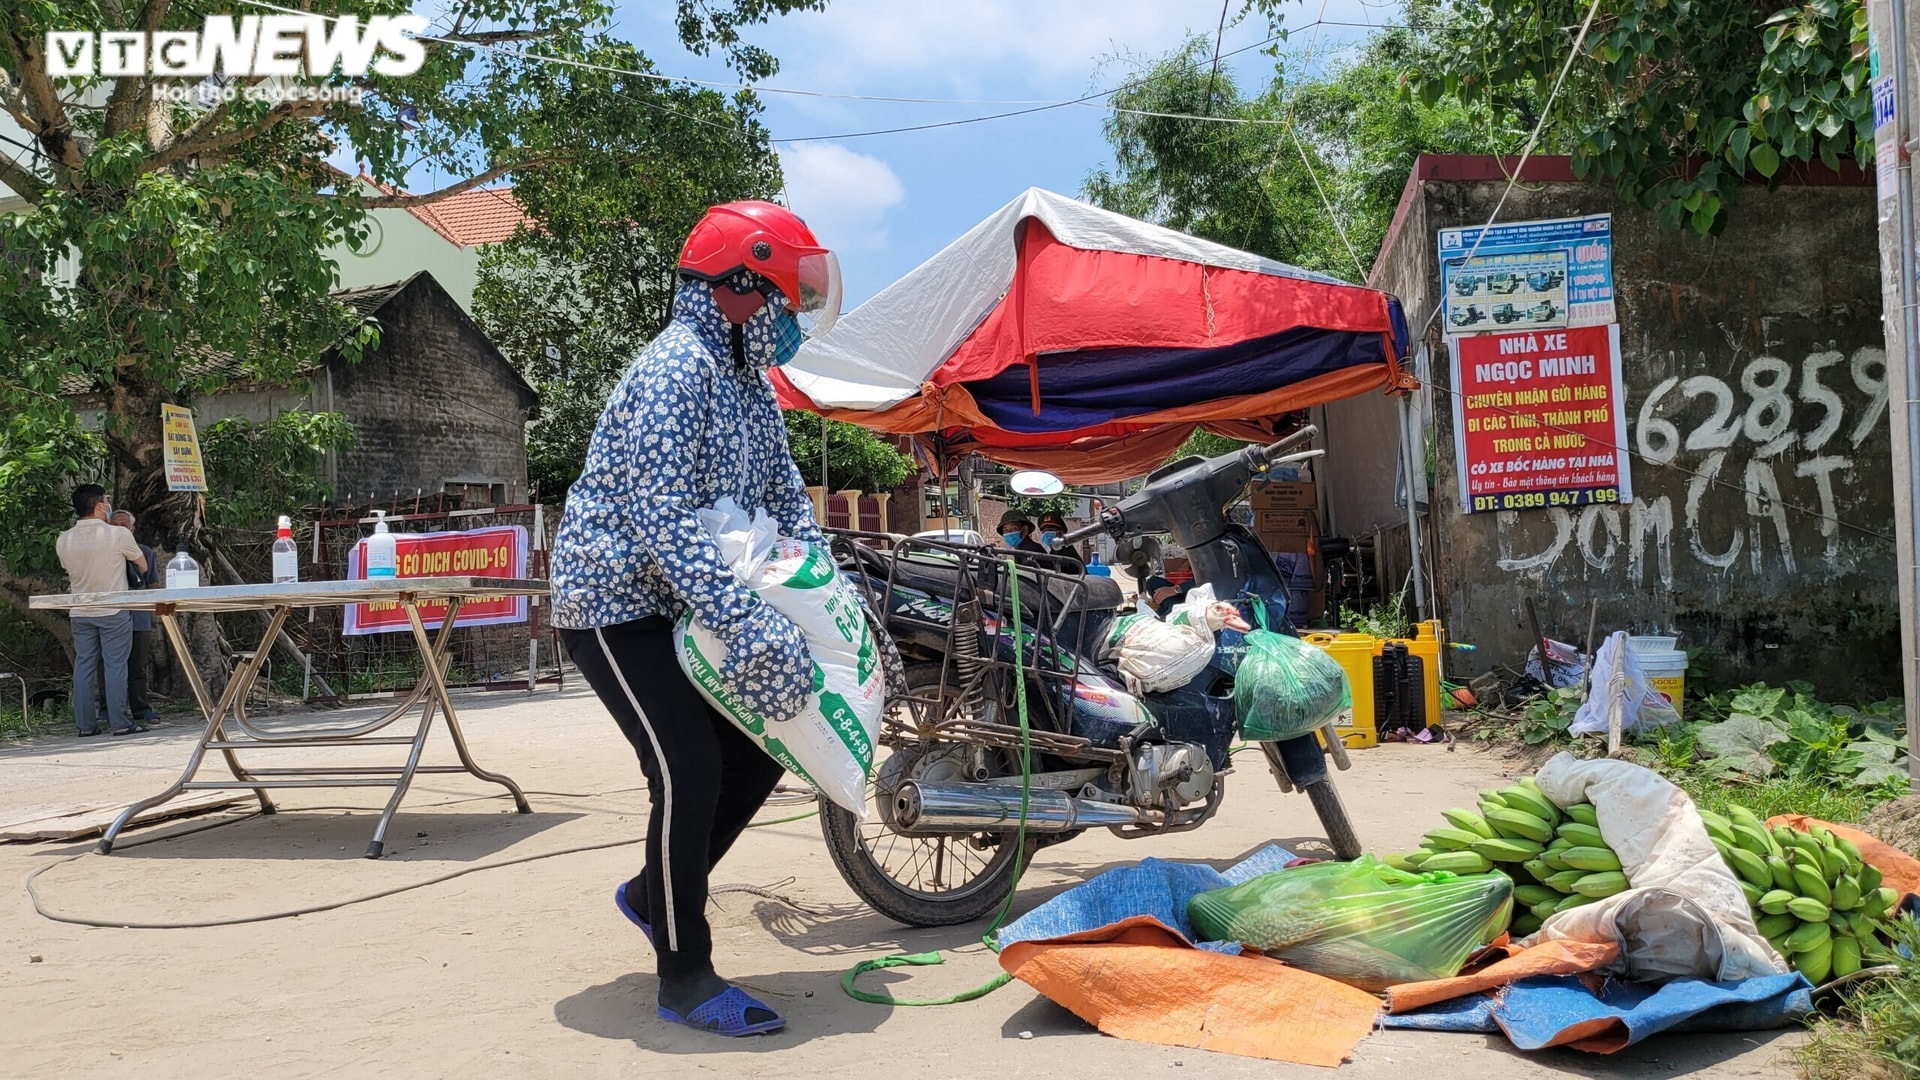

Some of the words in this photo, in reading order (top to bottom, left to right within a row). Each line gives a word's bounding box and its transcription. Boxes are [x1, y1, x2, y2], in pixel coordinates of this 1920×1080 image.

[1500, 333, 1538, 355] NHÀ
[1544, 334, 1567, 351] XE
[1476, 361, 1532, 384] NGỌC
[1539, 355, 1595, 378] MINH
[1467, 391, 1512, 409] CHUYÊN
[1515, 387, 1548, 407] NHẬN
[1551, 384, 1571, 402] GỬI
[1575, 384, 1606, 400] HÀNG
[1468, 418, 1480, 432] ĐI
[1484, 414, 1507, 430] CÁC
[1543, 409, 1581, 426] THÀNH
[1584, 404, 1609, 423] PHỐ
[1493, 437, 1532, 453] TRONG
[1535, 432, 1551, 451] CẢ
[1553, 431, 1586, 449] NƯỚC
[1471, 461, 1487, 475] CÓ
[1489, 462, 1504, 474] XE
[1506, 455, 1530, 473] BỐC
[1532, 456, 1566, 471] HÀNG
[1568, 457, 1586, 472] TẠI
[1588, 452, 1615, 467] NHÀ
[1471, 480, 1483, 492] Uy
[1519, 476, 1534, 489] mật
[1535, 473, 1557, 489] thông
[1558, 473, 1570, 485] tin
[1571, 471, 1594, 485] khách
[1596, 470, 1616, 485] hàng
[1474, 495, 1499, 511] ĐT:
[1503, 493, 1545, 508] 0389
[1550, 490, 1580, 506] 947
[1585, 488, 1617, 504] 199
[403, 549, 419, 576] CÓ
[422, 551, 451, 577] DỊCH
[453, 546, 508, 572] COVID-19
[831, 706, 872, 764] 6-8-4+9S
